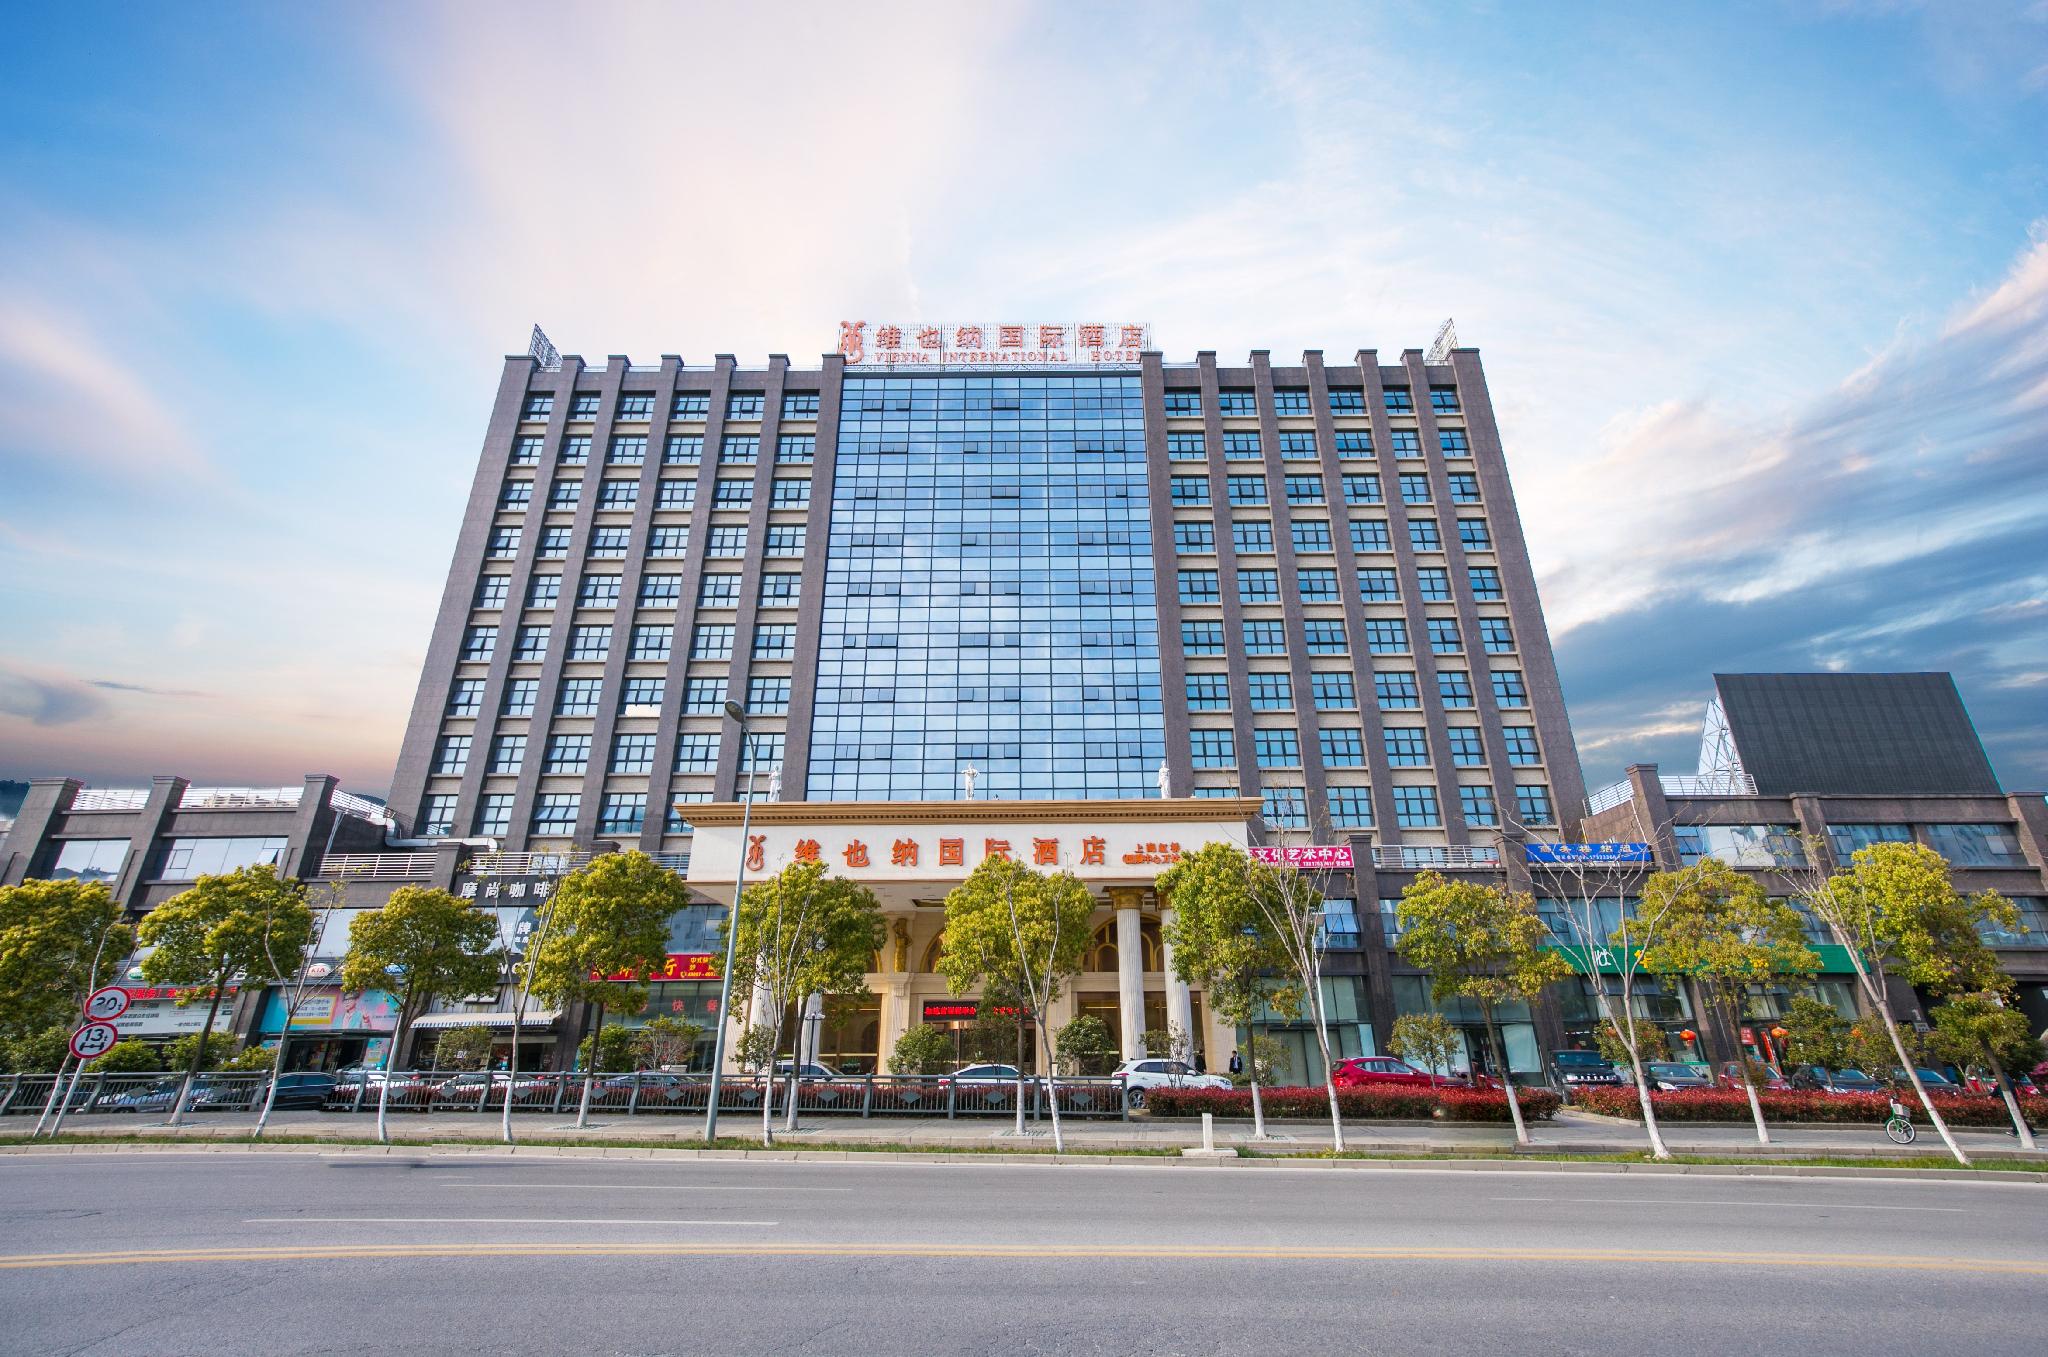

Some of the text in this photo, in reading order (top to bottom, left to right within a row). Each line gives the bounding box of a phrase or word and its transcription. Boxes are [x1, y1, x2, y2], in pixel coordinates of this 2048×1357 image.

[875, 325, 1146, 349] 维也纳国际酒店
[875, 351, 930, 364] VIENNA
[943, 351, 1068, 363] INTERNATIONAL
[793, 836, 1107, 867] 维也纳国际酒店
[460, 881, 550, 898] 摩尚咖啡
[84, 1028, 108, 1042] 13t
